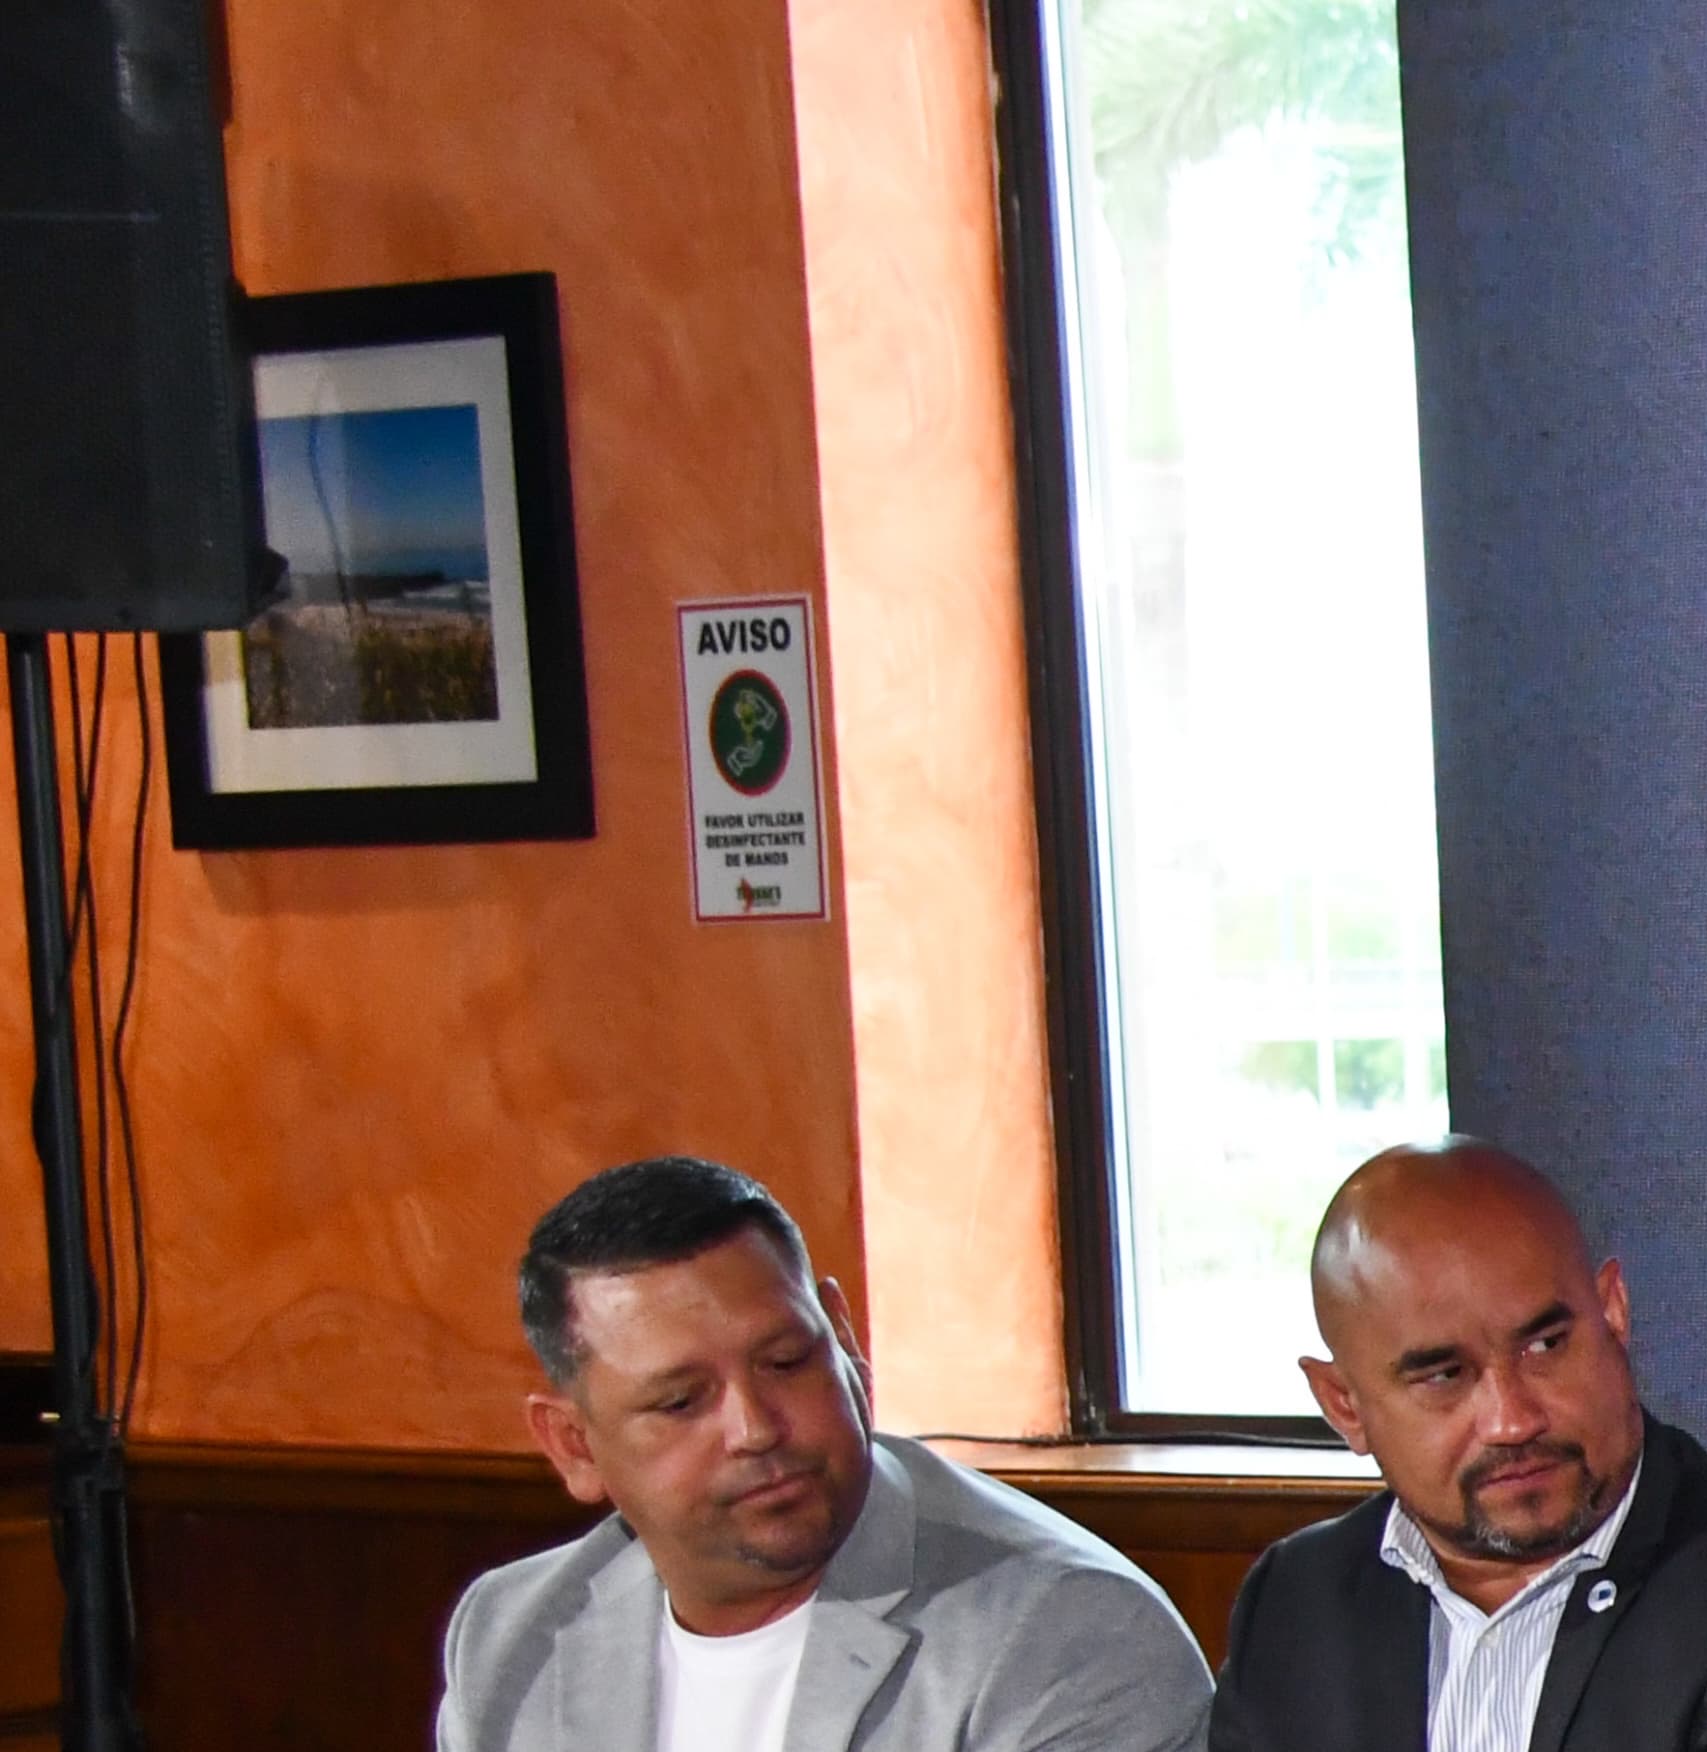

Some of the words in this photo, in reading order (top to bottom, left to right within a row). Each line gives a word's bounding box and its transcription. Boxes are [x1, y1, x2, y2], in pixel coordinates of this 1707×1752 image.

[697, 617, 792, 655] AVISO
[704, 814, 744, 829] FAVOR
[747, 811, 805, 828] UTILIZAR
[745, 851, 789, 867] MANOS
